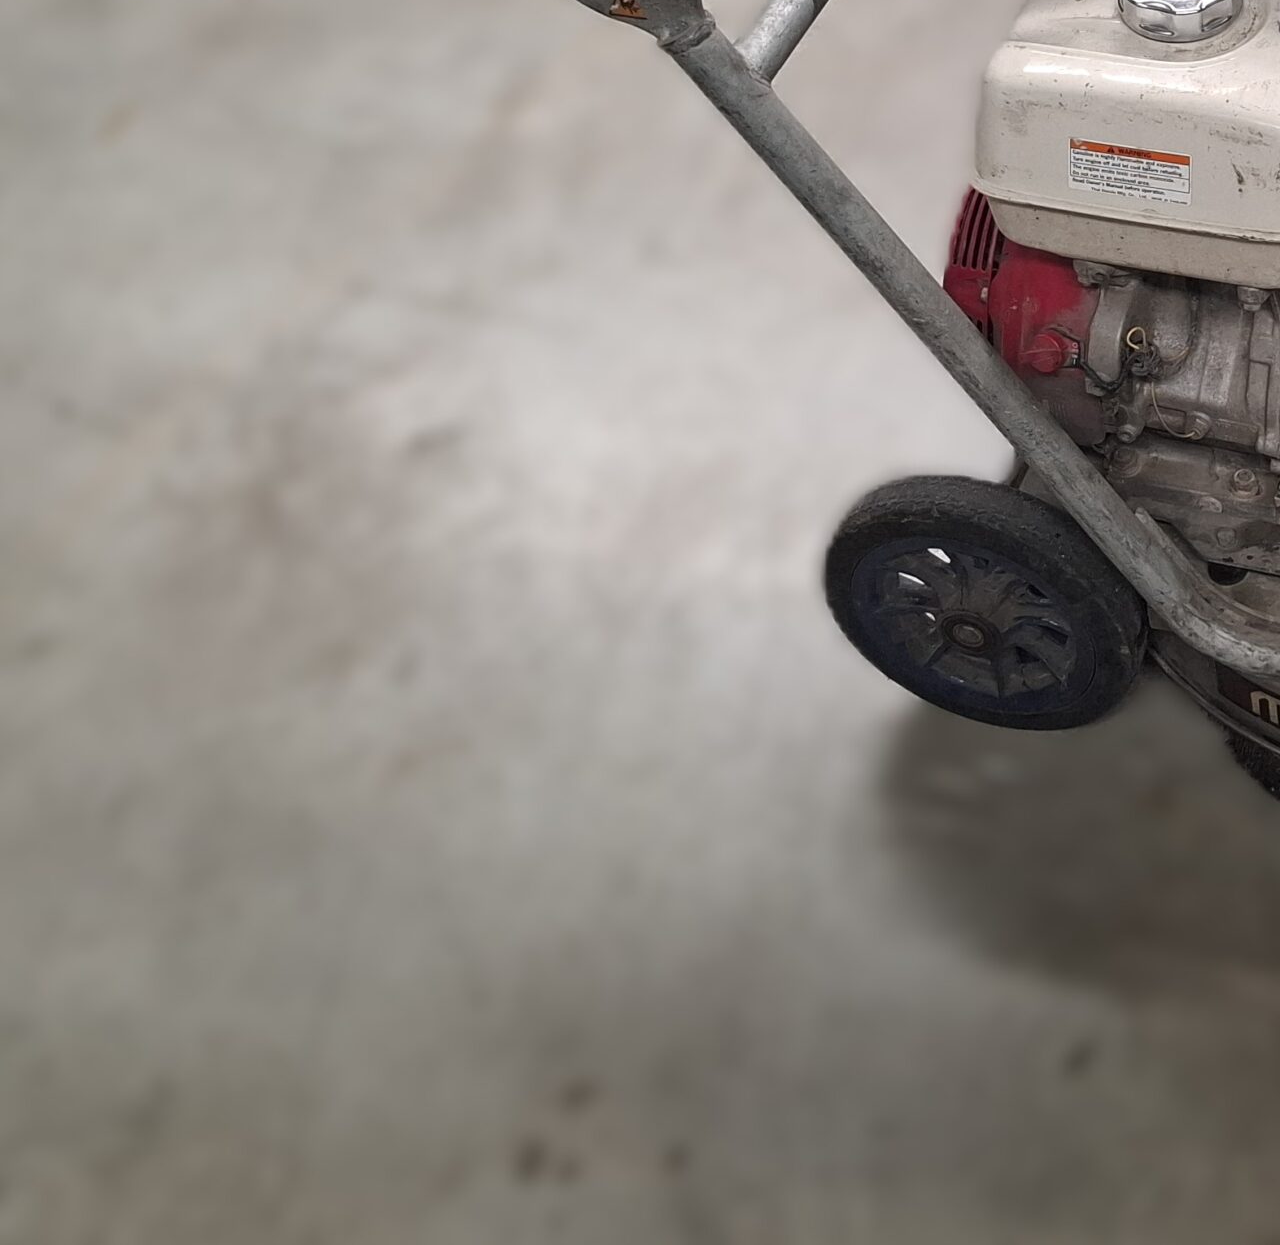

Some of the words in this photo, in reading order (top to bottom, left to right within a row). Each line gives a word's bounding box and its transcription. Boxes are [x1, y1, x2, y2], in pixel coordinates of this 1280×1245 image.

[1118, 147, 1151, 158] WARNING
[1085, 179, 1105, 187] Owner's
[1114, 176, 1136, 184] enclosed
